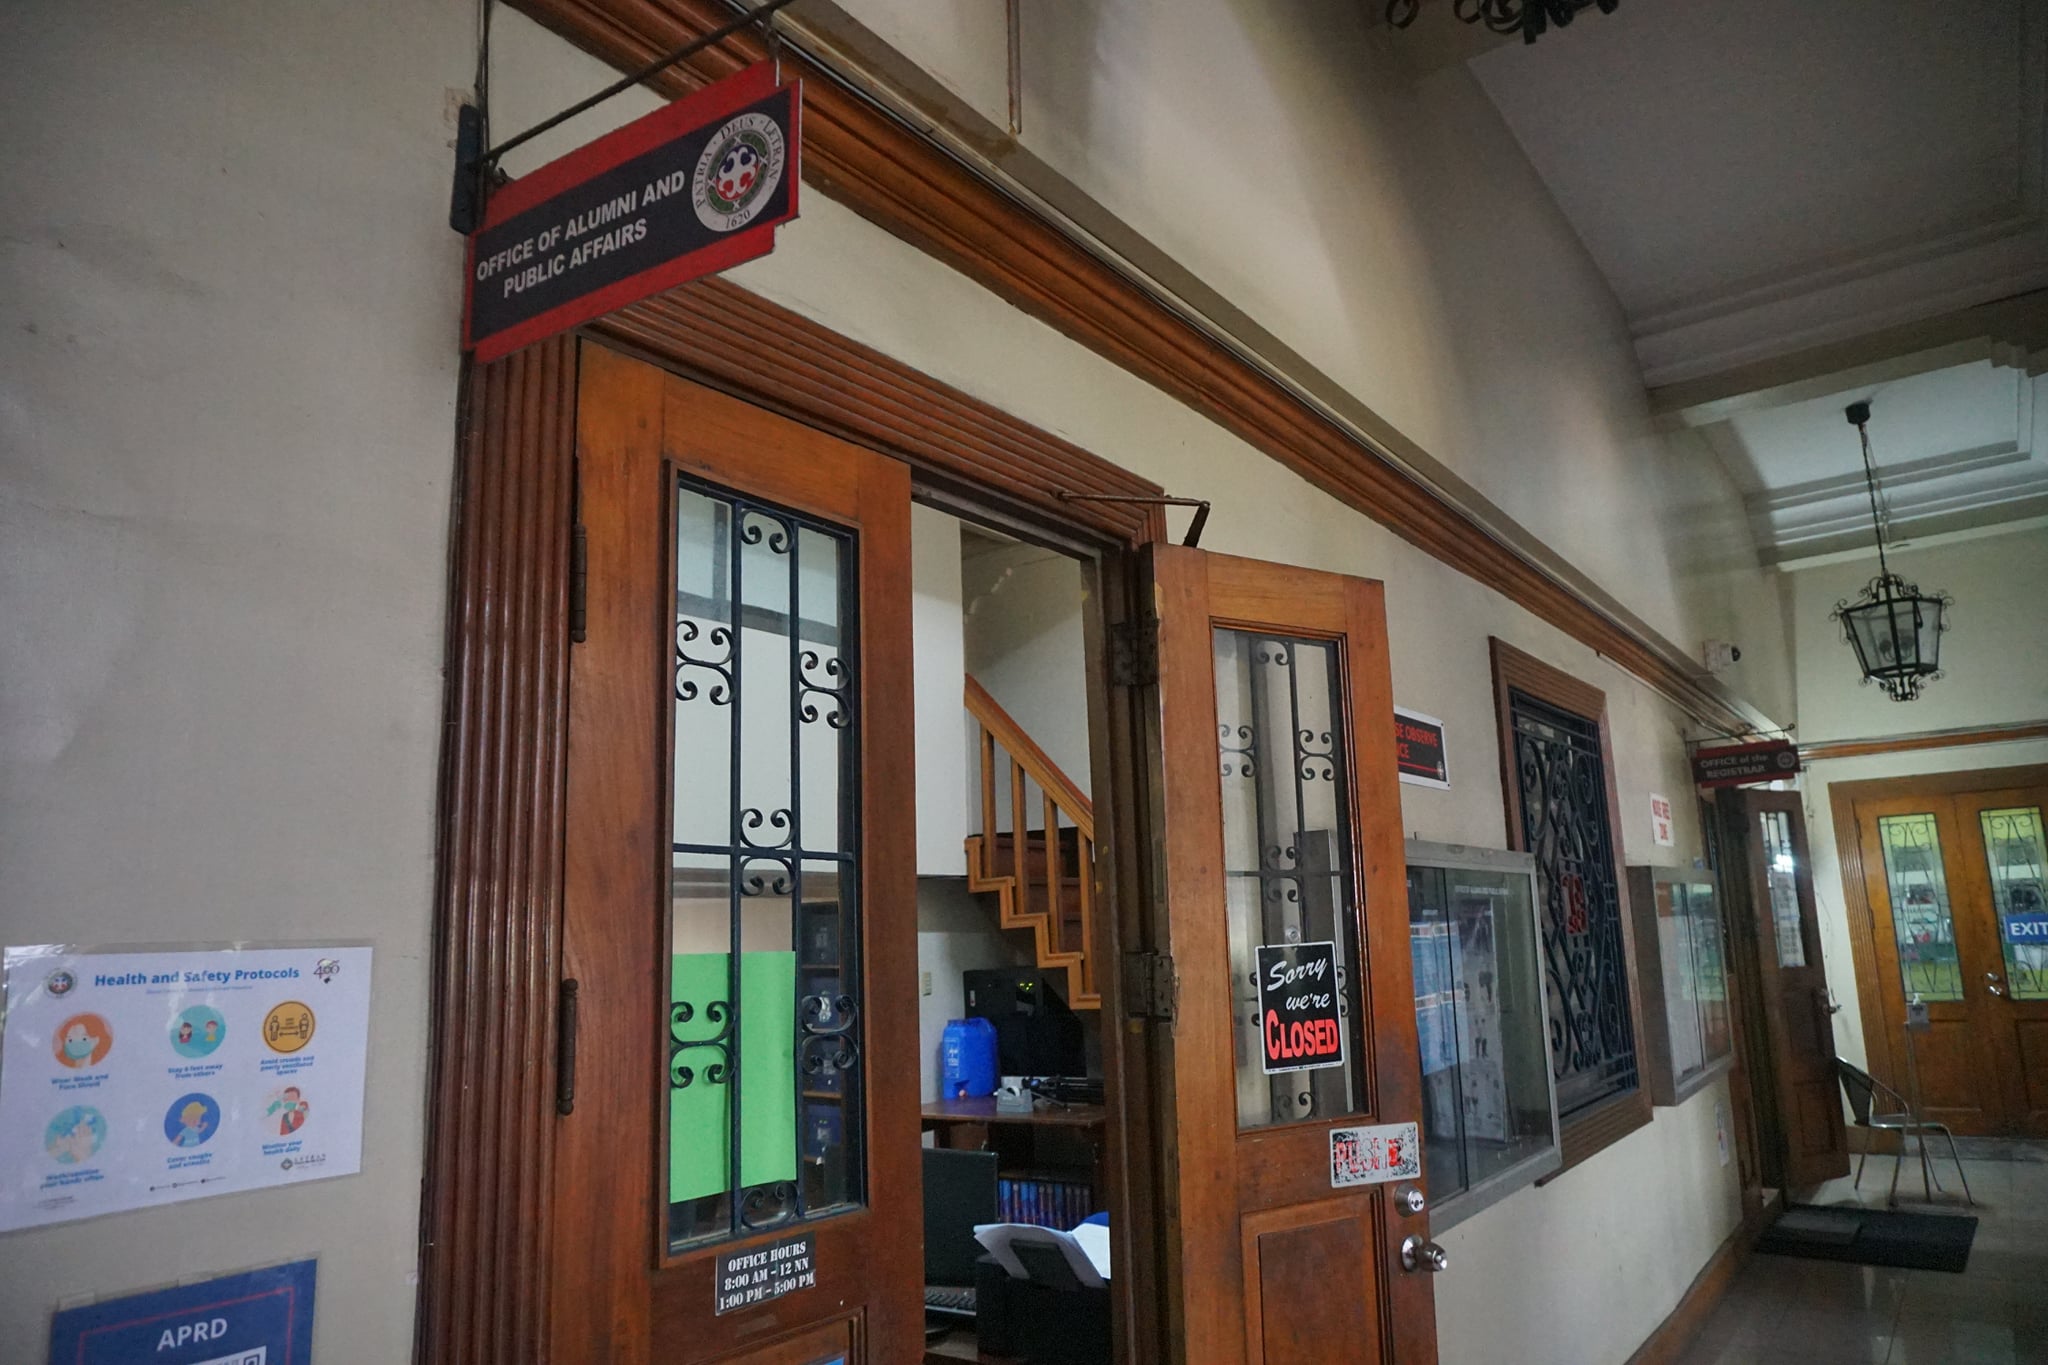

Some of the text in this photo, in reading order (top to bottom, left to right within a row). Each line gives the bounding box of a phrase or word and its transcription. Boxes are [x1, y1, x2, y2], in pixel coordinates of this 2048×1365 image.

[477, 170, 685, 281] OFFICE OF ALUMNI AND
[725, 209, 751, 229] 1620
[503, 218, 647, 298] PUBLIC AFFAIRS
[2010, 921, 2048, 936] EXIT
[95, 967, 300, 987] Health and Safety Protocols
[1266, 957, 1327, 992] Sorry
[1285, 992, 1331, 1010] we're
[1265, 1008, 1339, 1060] CLOSED
[727, 1241, 807, 1272] OFFICE HOURS
[719, 1292, 743, 1310] 1:00
[746, 1286, 763, 1303] PM
[774, 1278, 796, 1296] 5:00
[798, 1272, 815, 1288] PM
[724, 1273, 749, 1291] 8:00
[751, 1268, 768, 1284] AM
[780, 1261, 792, 1276] 12
[794, 1257, 809, 1272] NN
[156, 1317, 228, 1352] APRD
